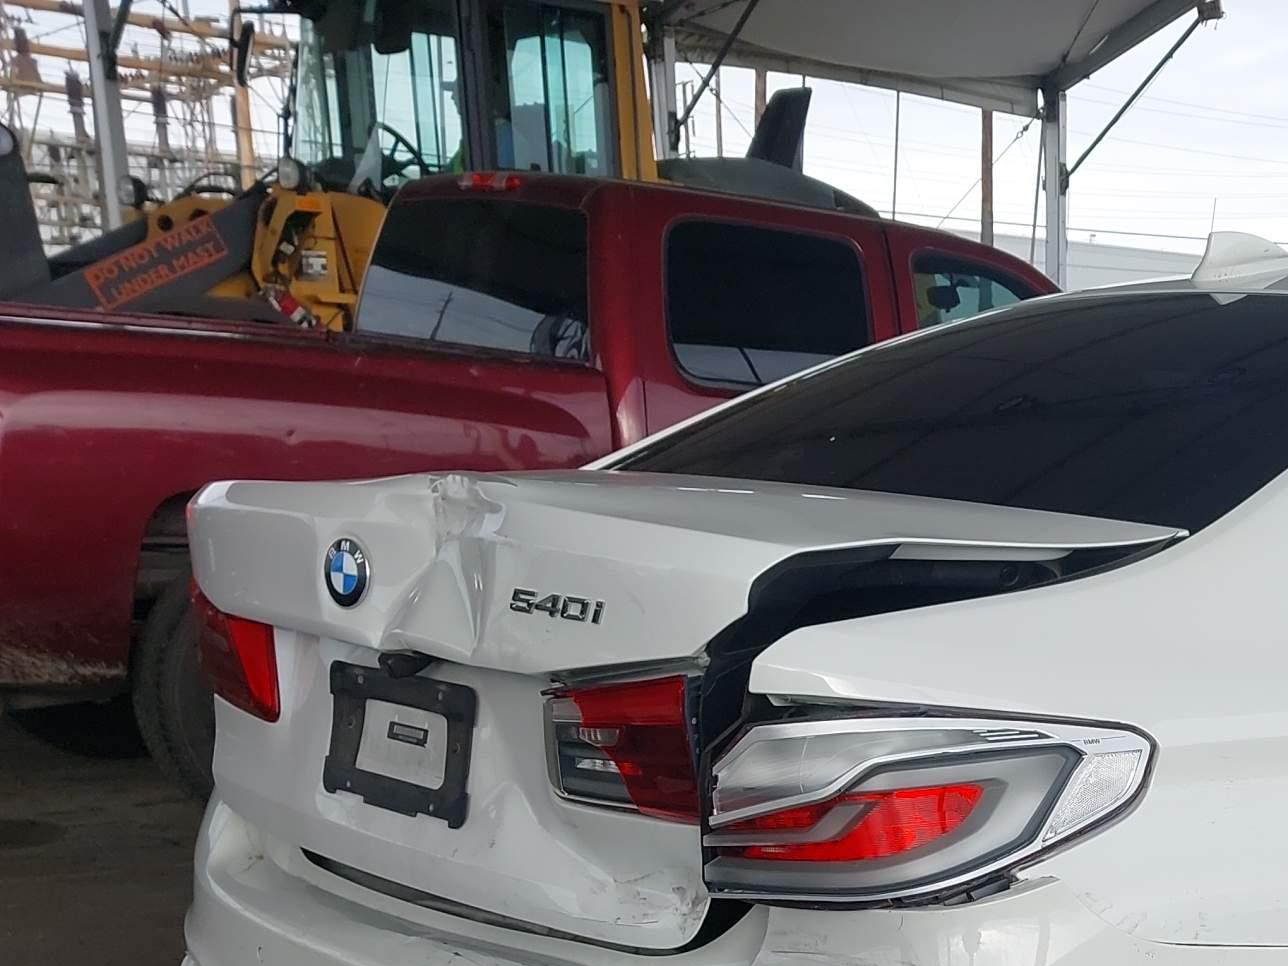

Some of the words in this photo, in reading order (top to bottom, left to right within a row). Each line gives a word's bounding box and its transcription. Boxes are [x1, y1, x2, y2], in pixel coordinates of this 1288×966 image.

[92, 264, 118, 283] DO
[119, 246, 158, 272] NOT
[160, 217, 214, 250] WALK
[112, 264, 170, 298] UNDER
[172, 241, 218, 271] MAST
[328, 540, 365, 564] BMW
[509, 587, 605, 624] 540i
